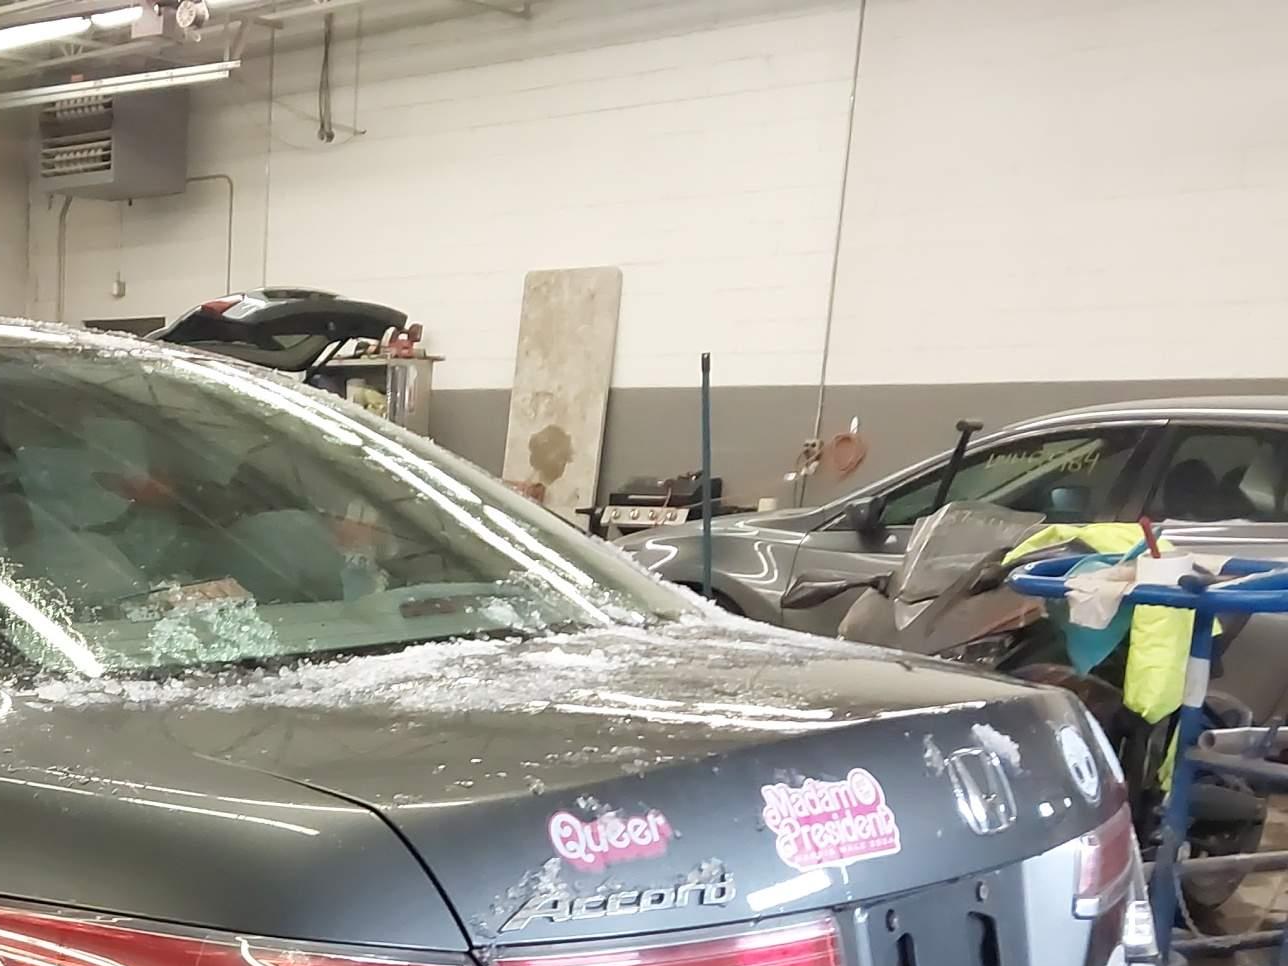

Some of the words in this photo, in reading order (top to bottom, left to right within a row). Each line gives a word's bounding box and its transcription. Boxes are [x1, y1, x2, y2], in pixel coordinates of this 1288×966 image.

[762, 780, 858, 826] Madam
[549, 810, 667, 864] Queer
[777, 806, 894, 861] President
[500, 876, 737, 934] Accord
